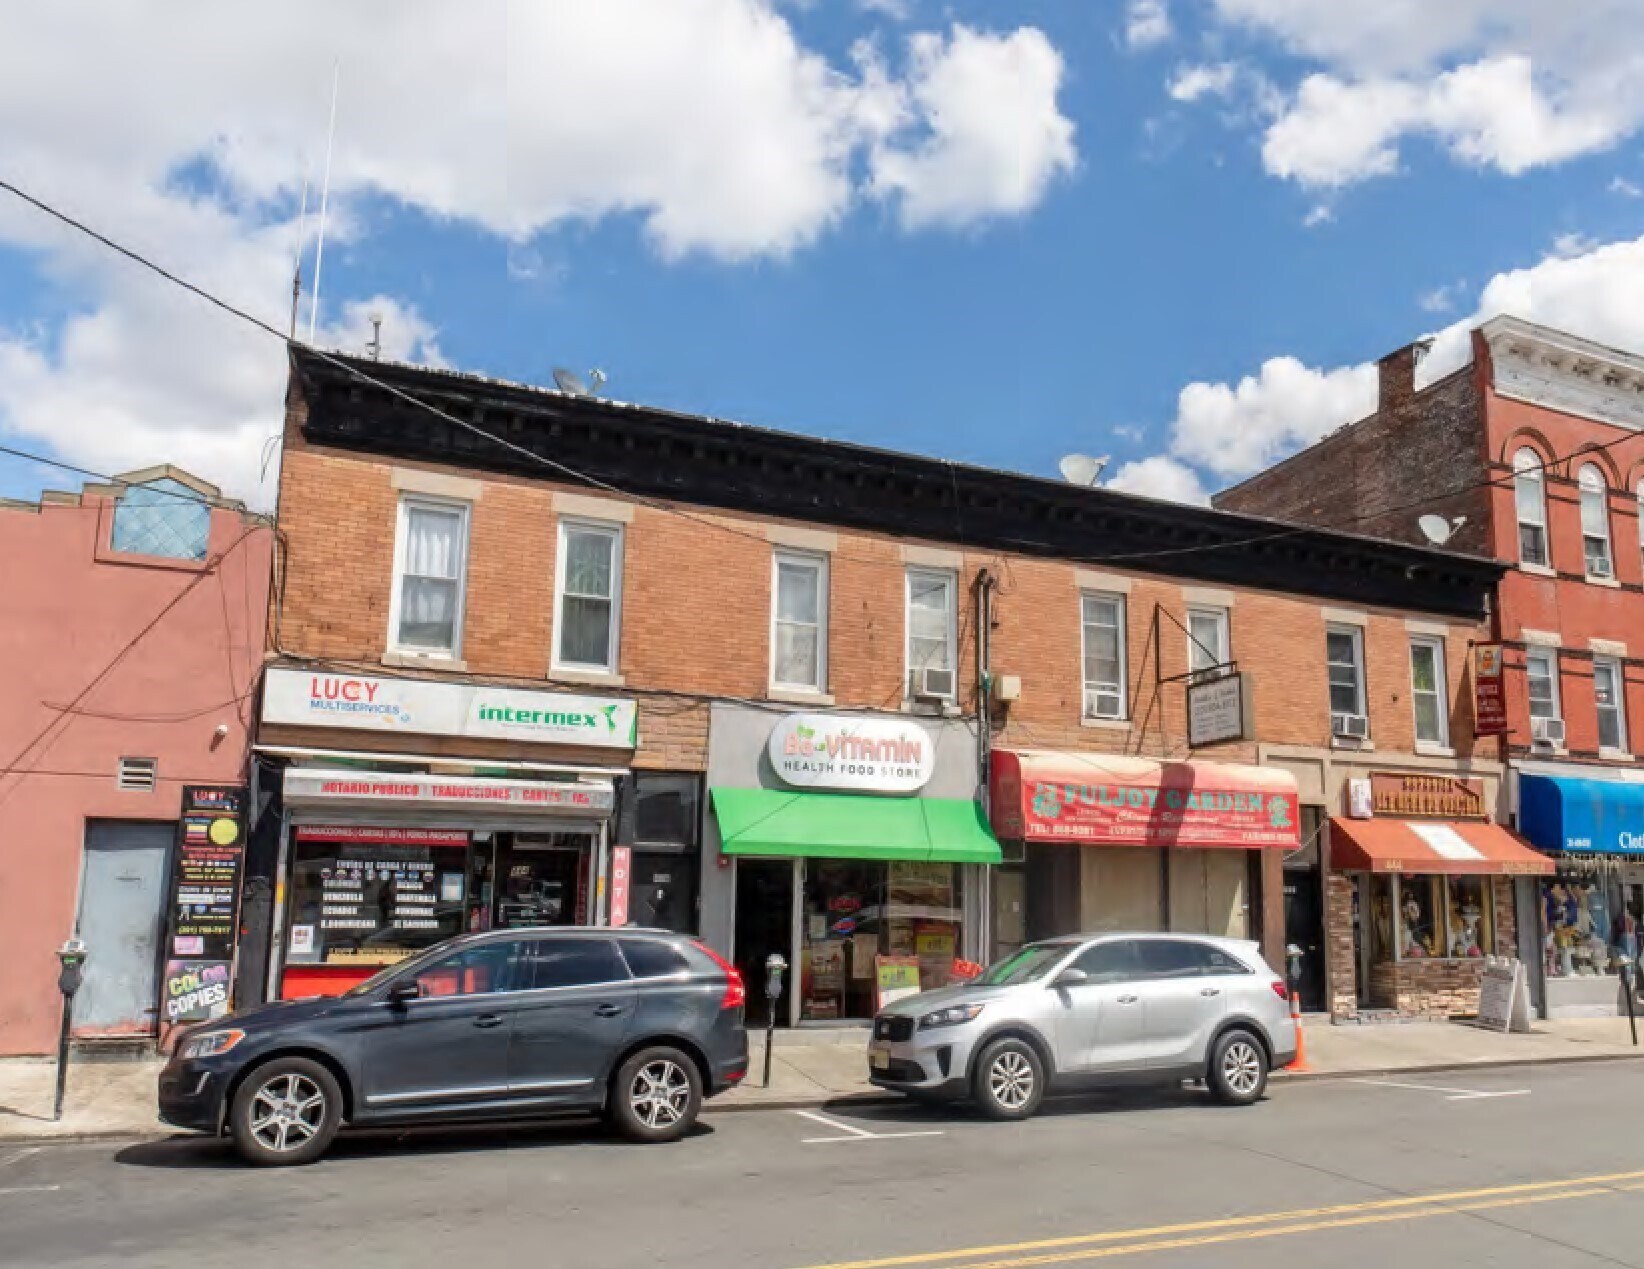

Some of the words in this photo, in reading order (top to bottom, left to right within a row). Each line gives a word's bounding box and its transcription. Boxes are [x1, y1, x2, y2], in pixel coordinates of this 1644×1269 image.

[311, 677, 379, 702] LUCY
[310, 699, 400, 716] MULTISERVICES
[479, 703, 598, 728] intermex
[784, 761, 834, 774] HEALTH
[840, 764, 876, 776] FOOD
[881, 766, 922, 778] STORE
[321, 782, 370, 795] NOTARIO
[372, 784, 420, 797] PUBLICO
[432, 785, 511, 800] TRADUCCIONES
[1165, 789, 1263, 812] GARDEN
[166, 982, 227, 1018] COPIES
